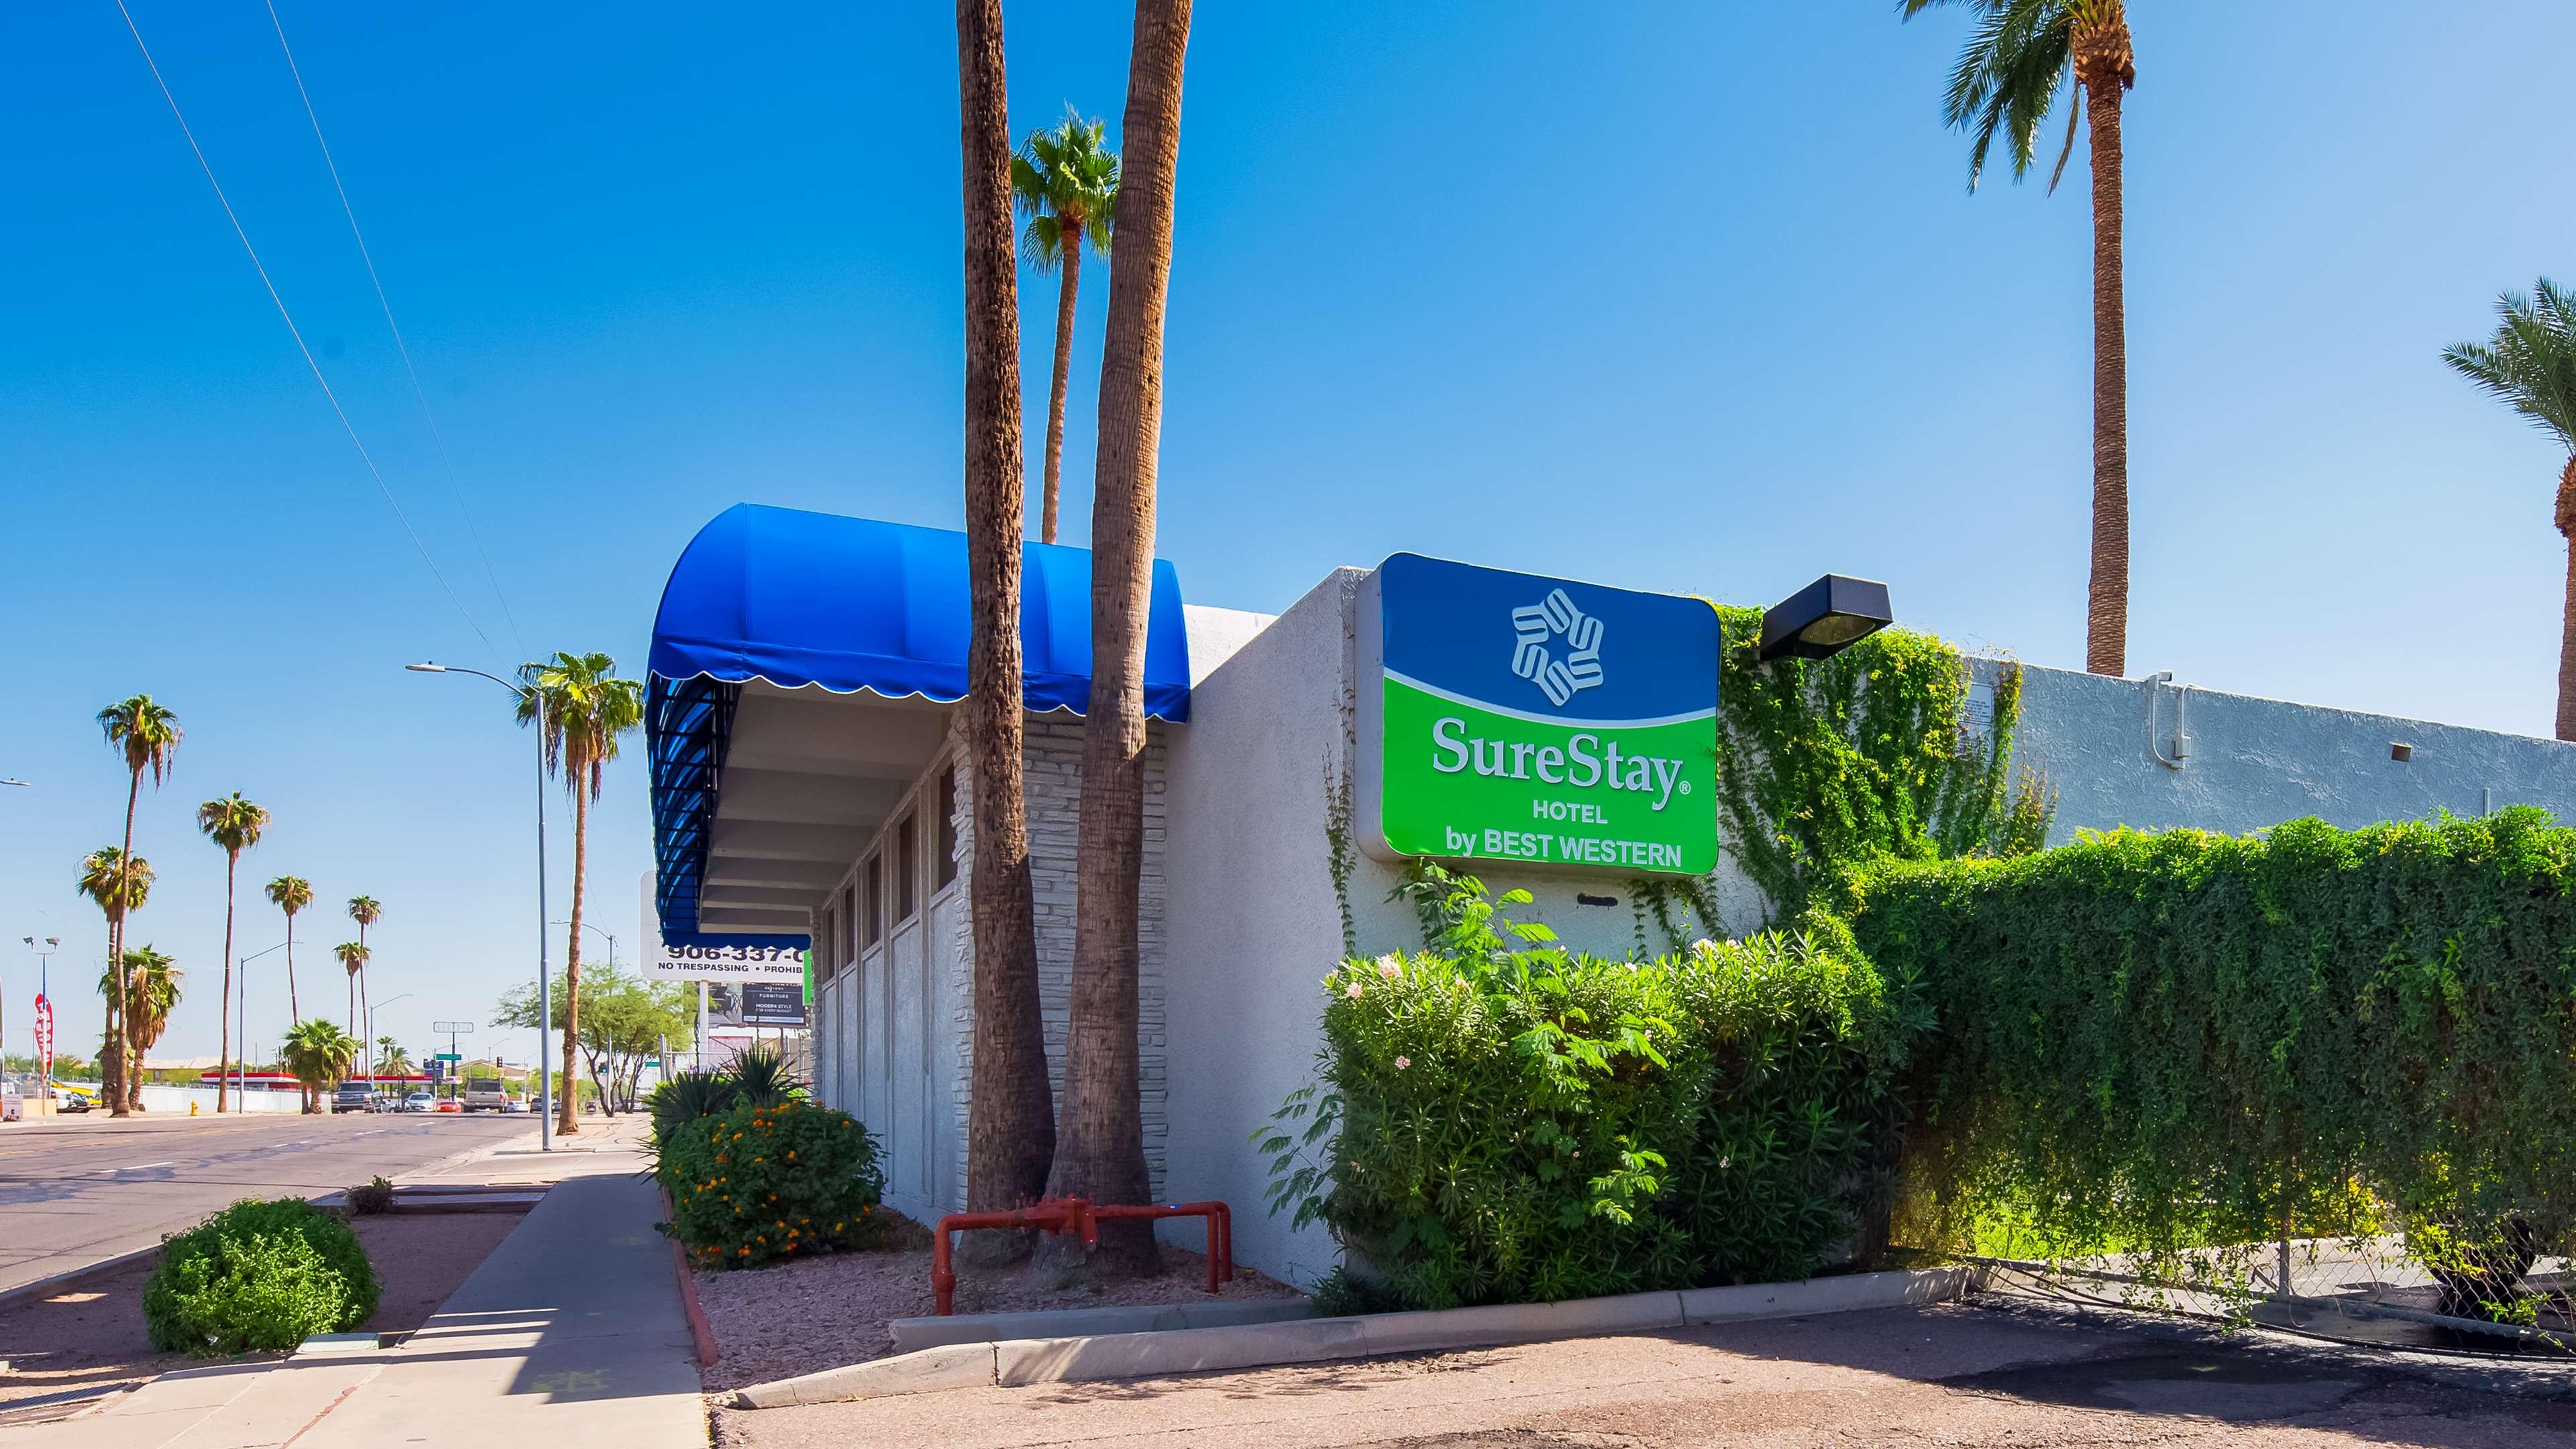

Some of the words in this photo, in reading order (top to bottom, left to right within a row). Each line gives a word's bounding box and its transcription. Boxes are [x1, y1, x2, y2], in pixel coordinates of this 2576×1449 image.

[1533, 800, 1608, 824] HOTEL
[1446, 826, 1477, 857] by
[1485, 828, 1553, 857] BEST
[1559, 836, 1681, 867] WESTERN
[658, 962, 674, 970] NO
[677, 963, 749, 972] TRESPASSING
